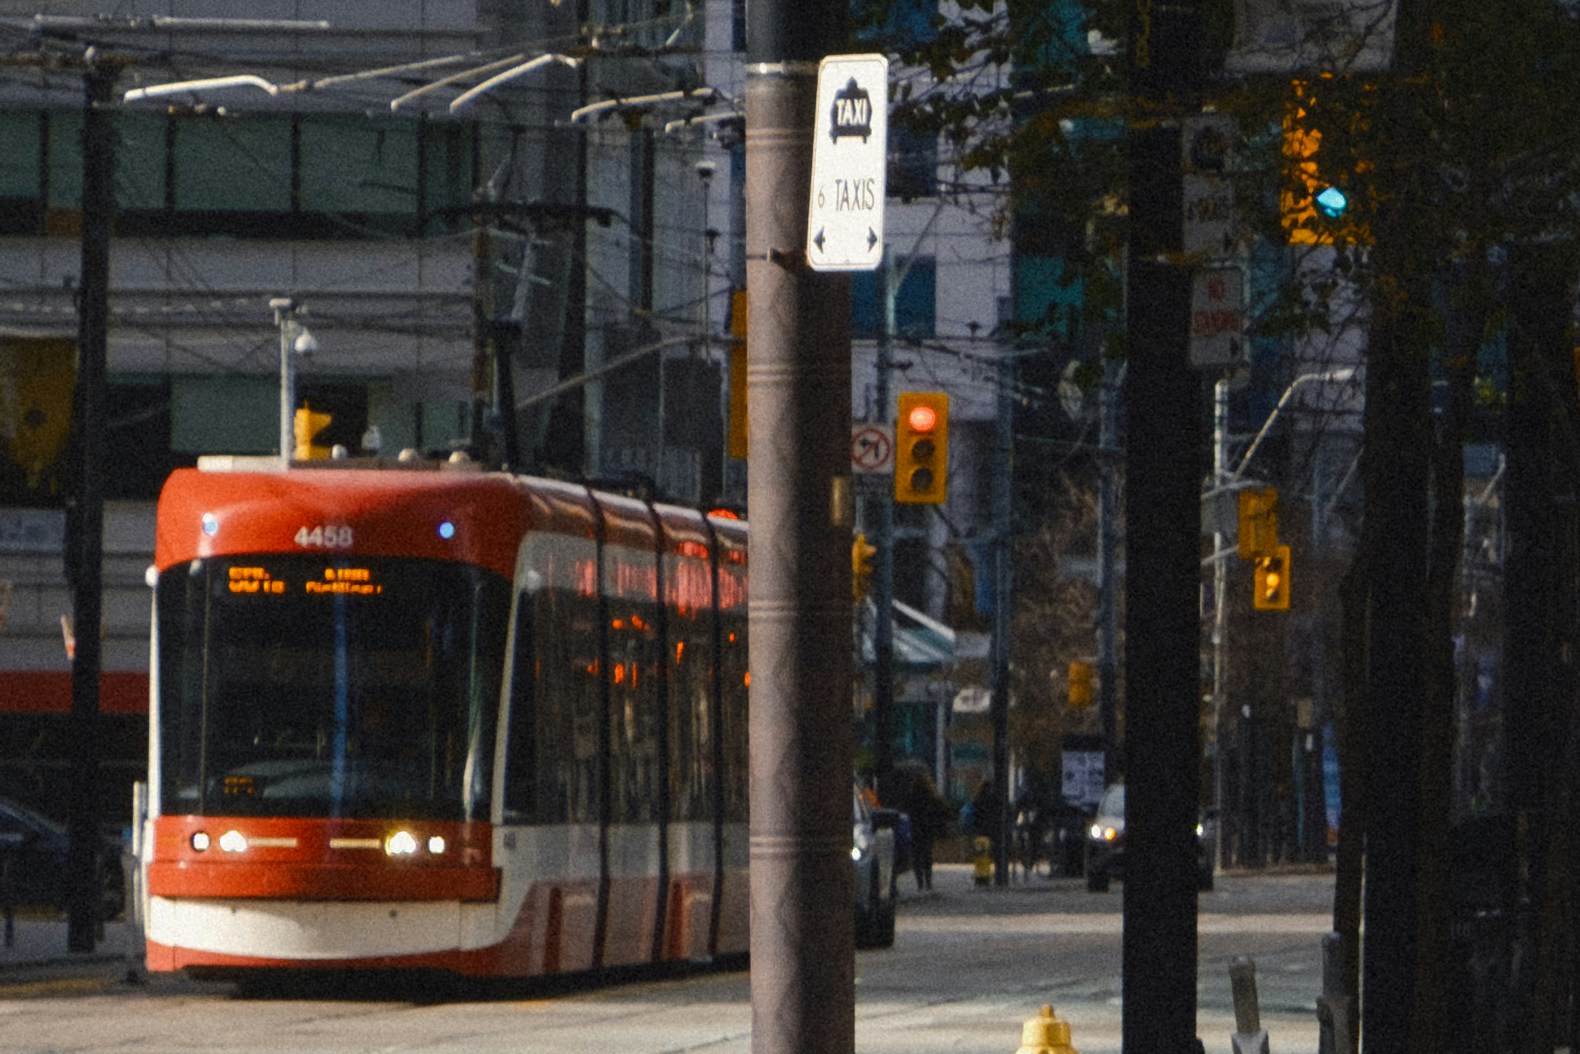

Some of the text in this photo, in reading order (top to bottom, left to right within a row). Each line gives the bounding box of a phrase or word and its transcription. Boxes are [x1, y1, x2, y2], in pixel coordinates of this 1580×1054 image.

[836, 98, 867, 126] TAXI
[817, 177, 875, 211] 6 TAXIS
[294, 525, 353, 548] 4458
